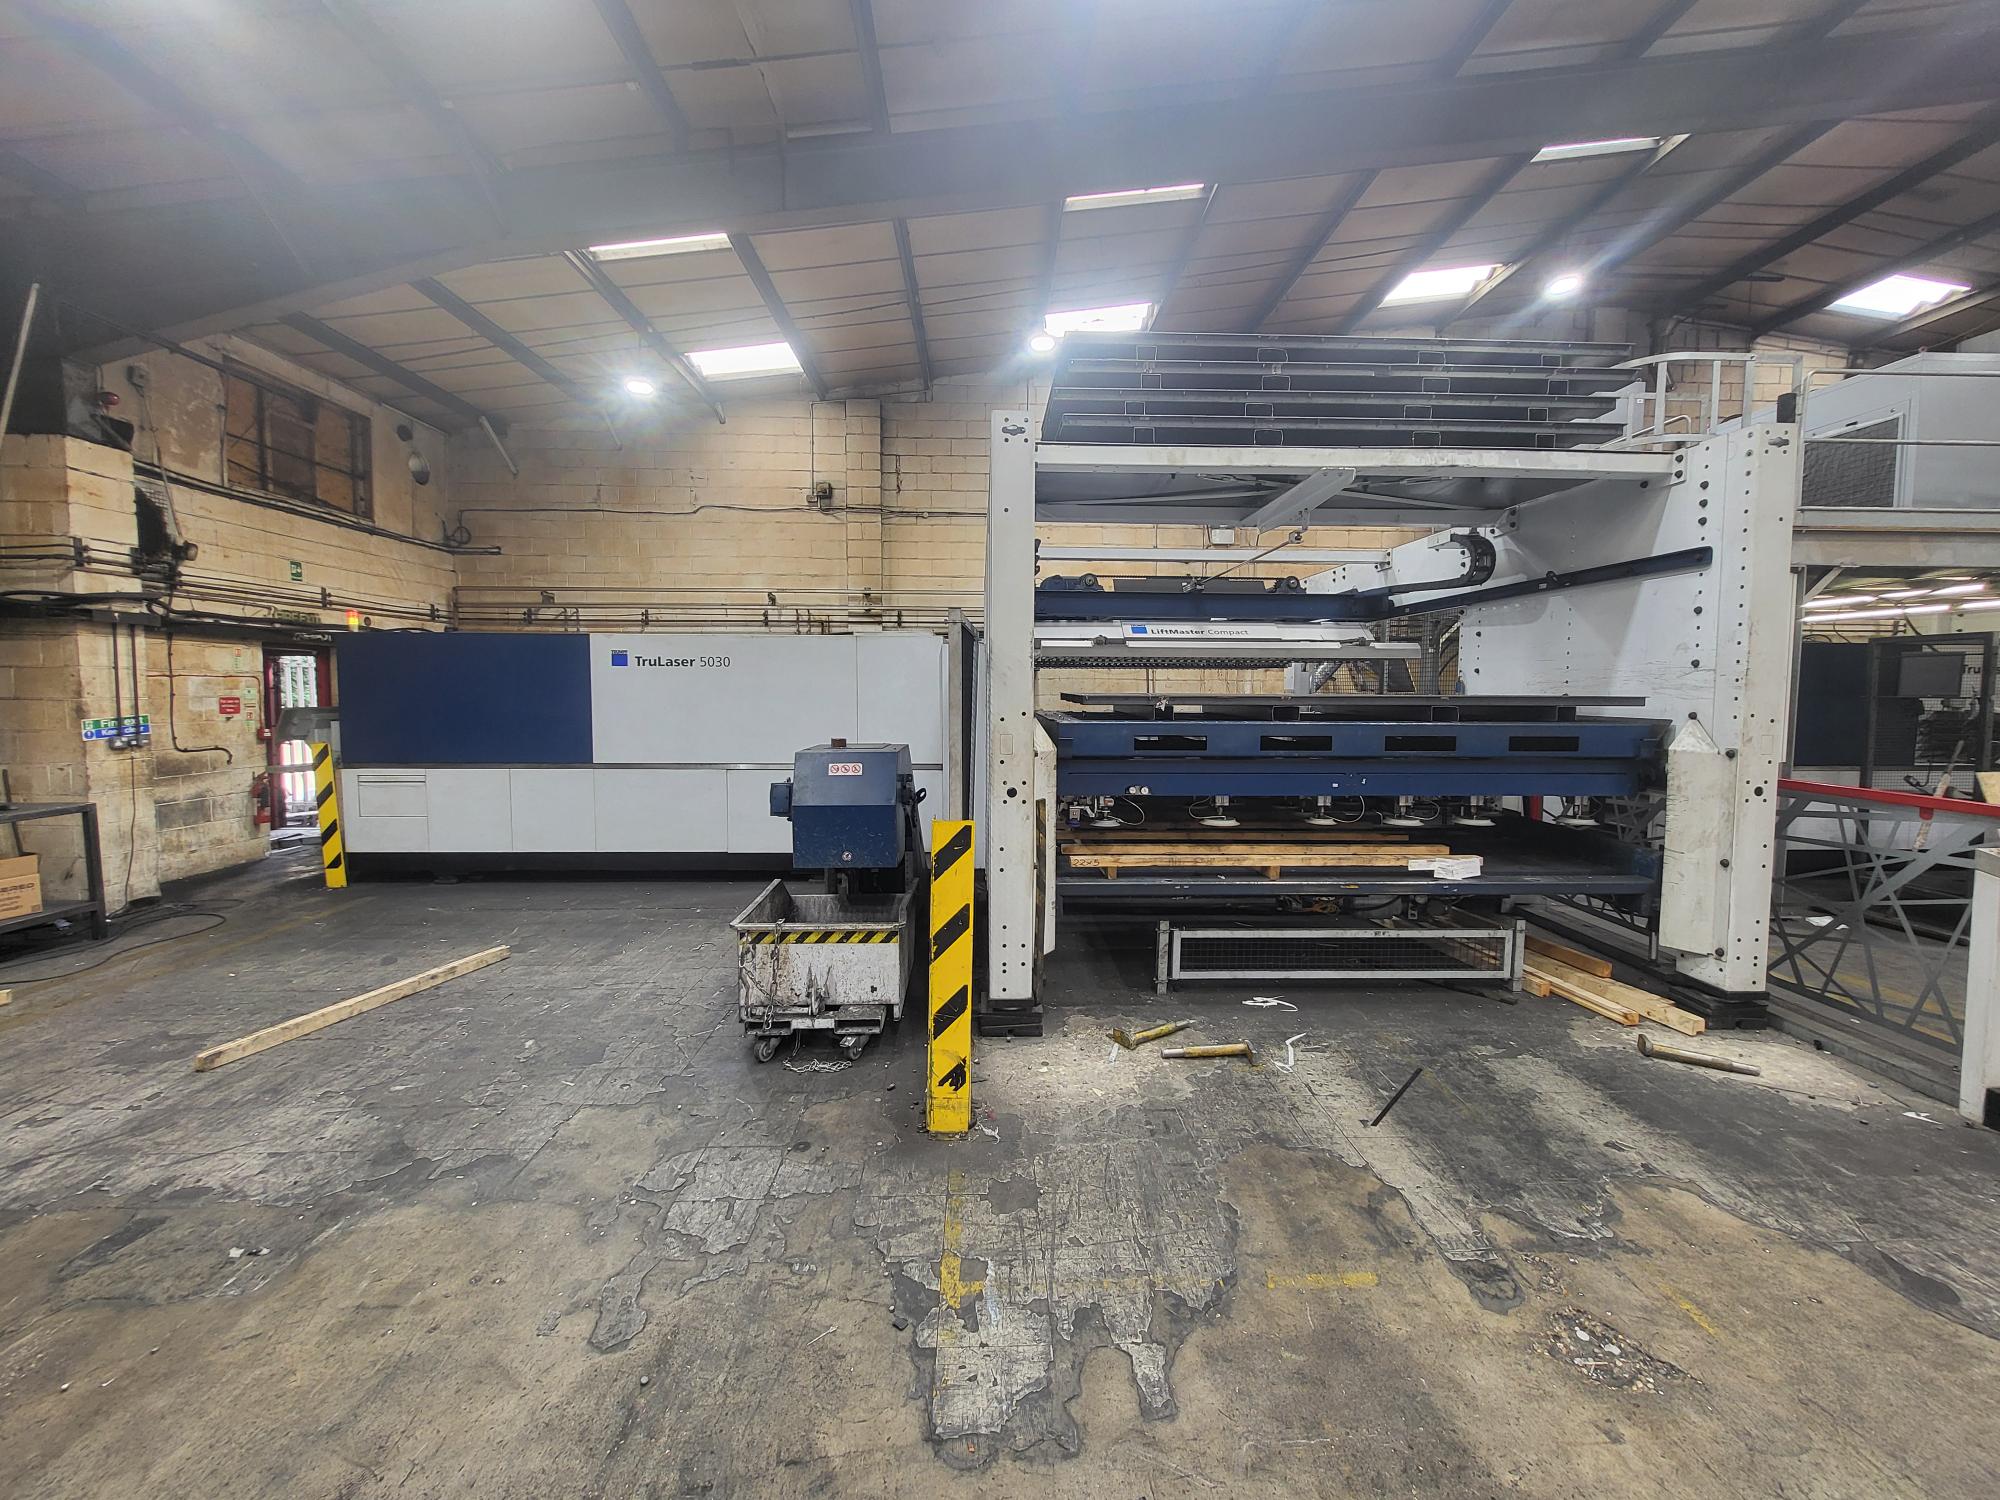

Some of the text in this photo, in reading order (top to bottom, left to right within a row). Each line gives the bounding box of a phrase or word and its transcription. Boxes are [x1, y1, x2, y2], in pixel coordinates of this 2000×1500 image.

[635, 656, 731, 667] TruLaser 5030
[124, 716, 144, 726] ext
[101, 726, 144, 736] Kee cler
